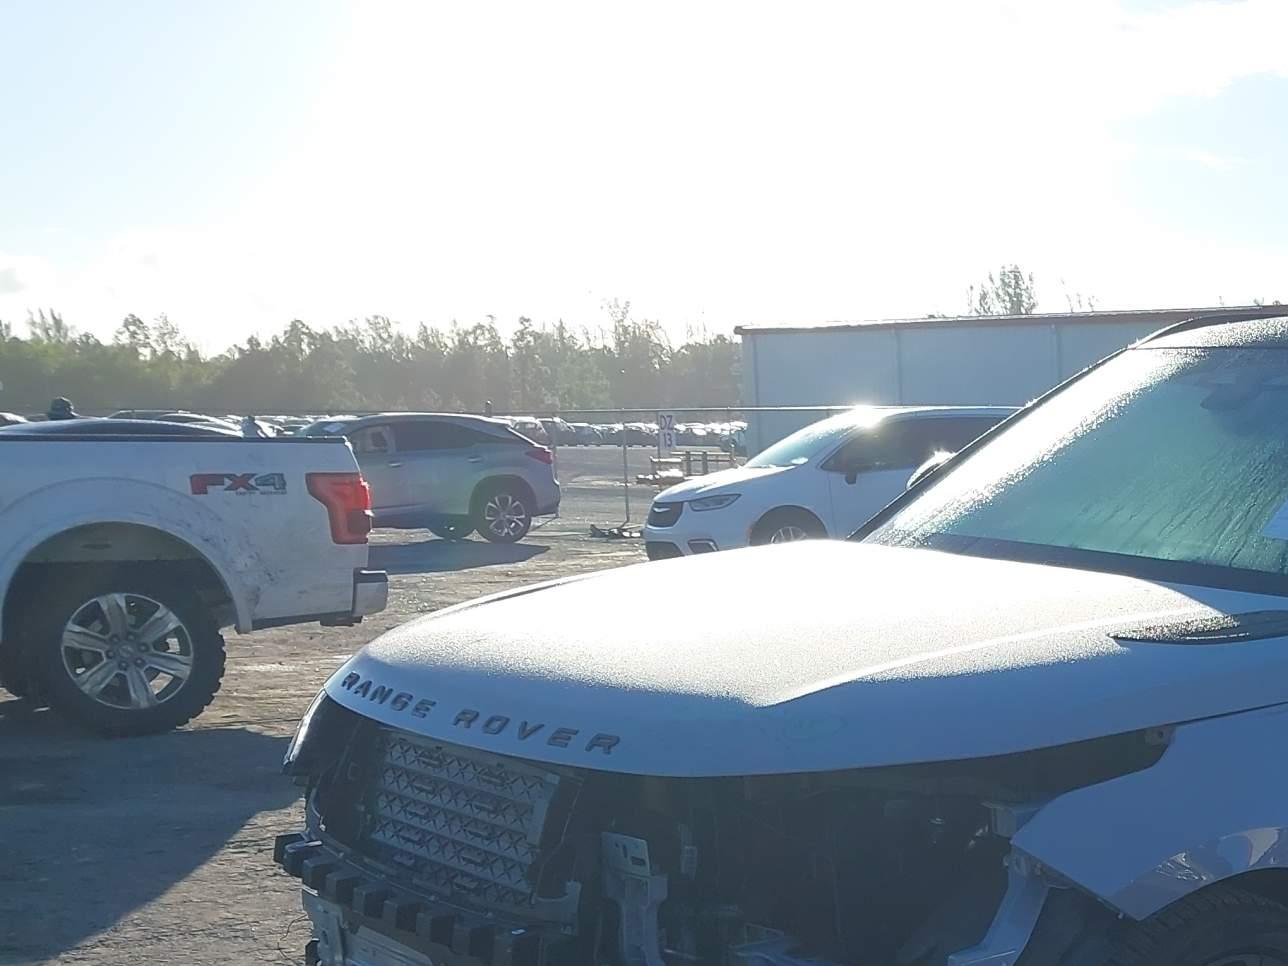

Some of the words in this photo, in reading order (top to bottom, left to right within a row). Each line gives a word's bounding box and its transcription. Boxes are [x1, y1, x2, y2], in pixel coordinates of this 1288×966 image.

[190, 473, 287, 495] FX4
[340, 671, 437, 719] RANGE
[452, 708, 621, 755] ROVER
